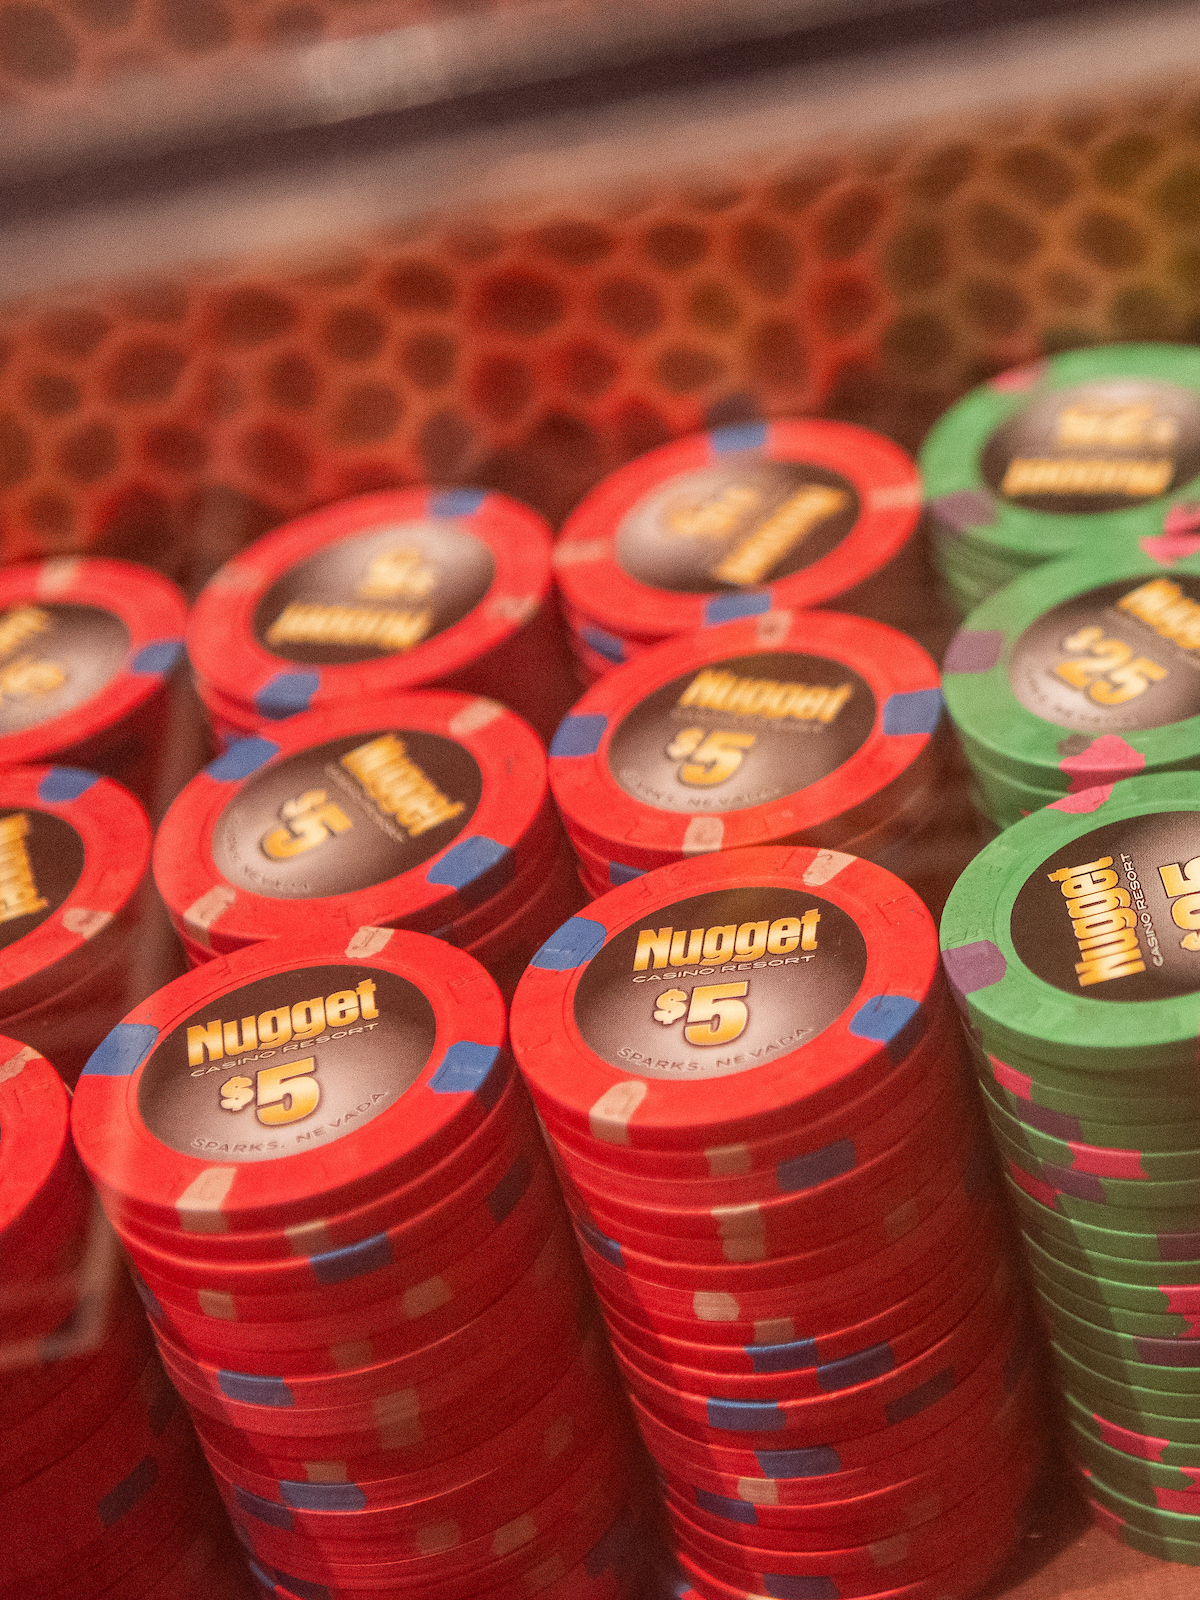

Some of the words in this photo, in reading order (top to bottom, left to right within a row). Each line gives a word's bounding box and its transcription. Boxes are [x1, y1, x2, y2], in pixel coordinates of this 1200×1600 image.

[1056, 626, 1167, 704] $25
[666, 727, 756, 785] $5
[262, 789, 353, 858] $5
[1119, 853, 1148, 910] RESORT
[633, 908, 820, 971] Nugget
[1047, 855, 1146, 987] Nugget
[1135, 912, 1164, 967] CASINO
[632, 967, 714, 983] CASINO
[720, 955, 815, 974] RESORT
[187, 978, 379, 1067] Nugget
[653, 980, 749, 1047] $5
[190, 1050, 277, 1077] CASINO
[282, 1023, 379, 1053] RESORT
[715, 1026, 814, 1068] NEVADA
[219, 1057, 320, 1126] $5
[295, 1090, 388, 1144] NEVADA
